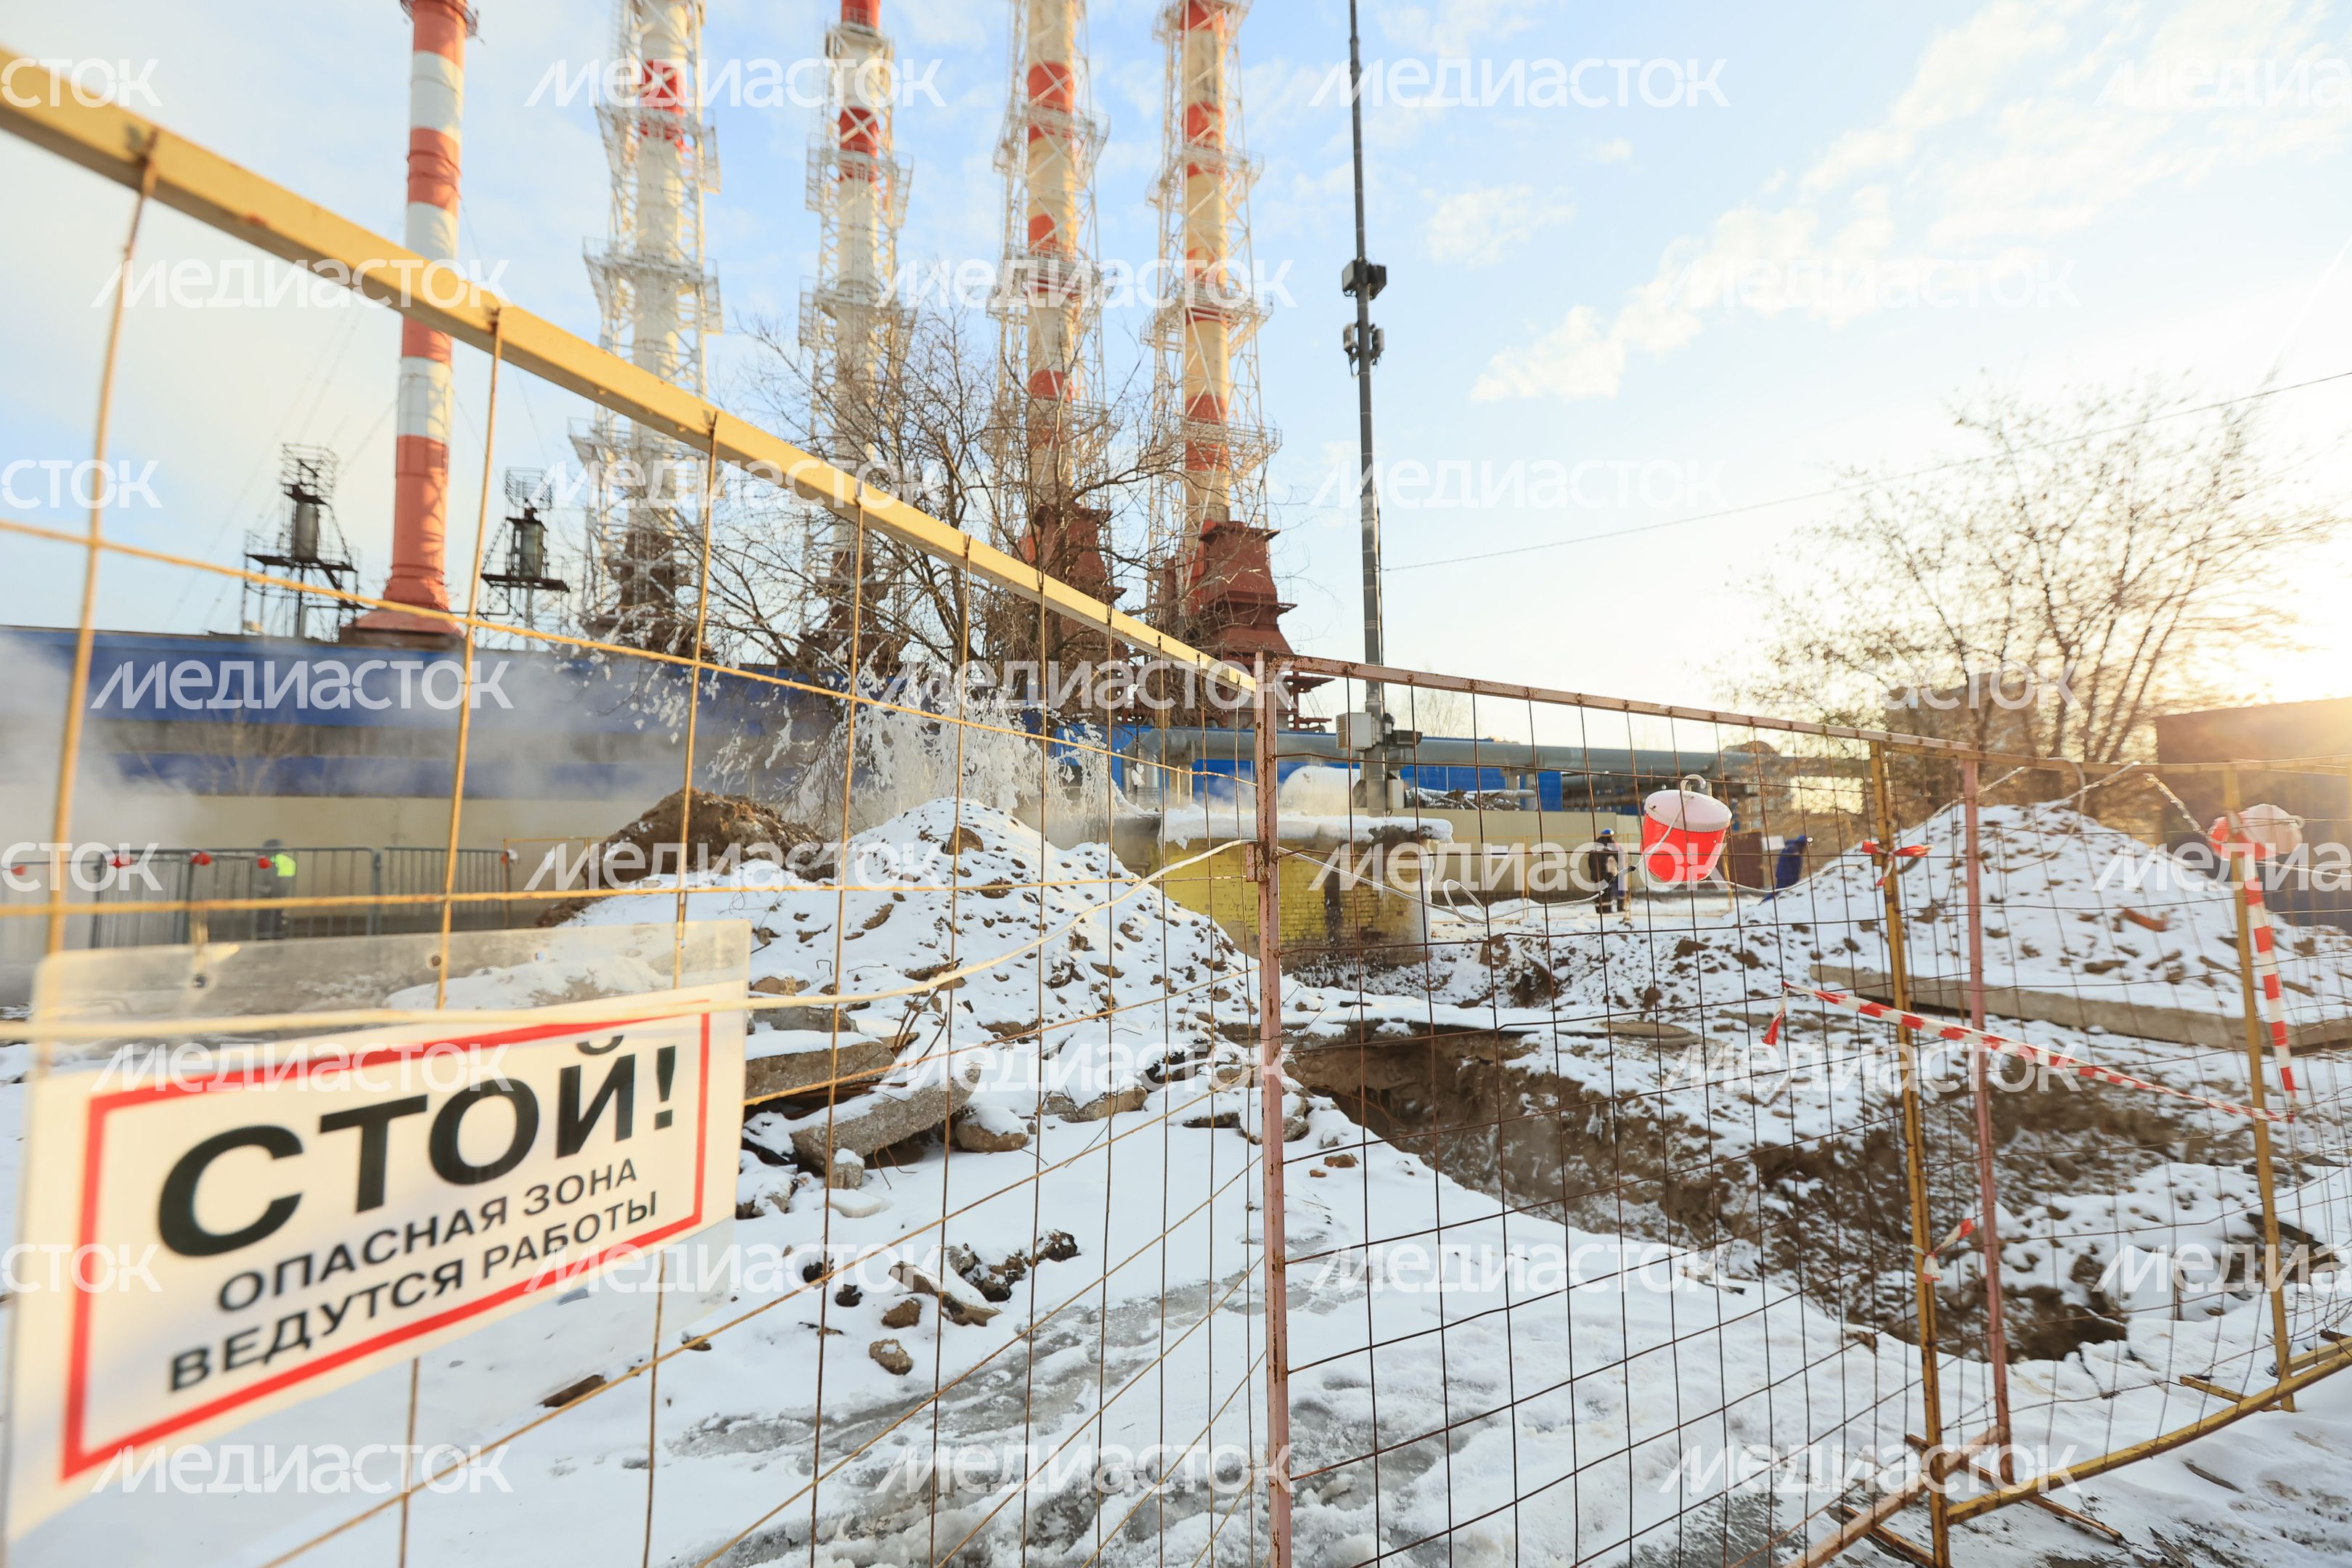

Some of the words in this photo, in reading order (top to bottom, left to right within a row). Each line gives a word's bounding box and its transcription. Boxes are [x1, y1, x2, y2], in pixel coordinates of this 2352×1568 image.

[156, 1034, 677, 1259] СТОЙ!
[217, 1196, 508, 1313] ОПАСНАЯ
[523, 1158, 638, 1216] ЗОНА
[168, 1258, 464, 1394] ВЕДУТСЯ
[482, 1191, 657, 1280] РАБОТЫ
